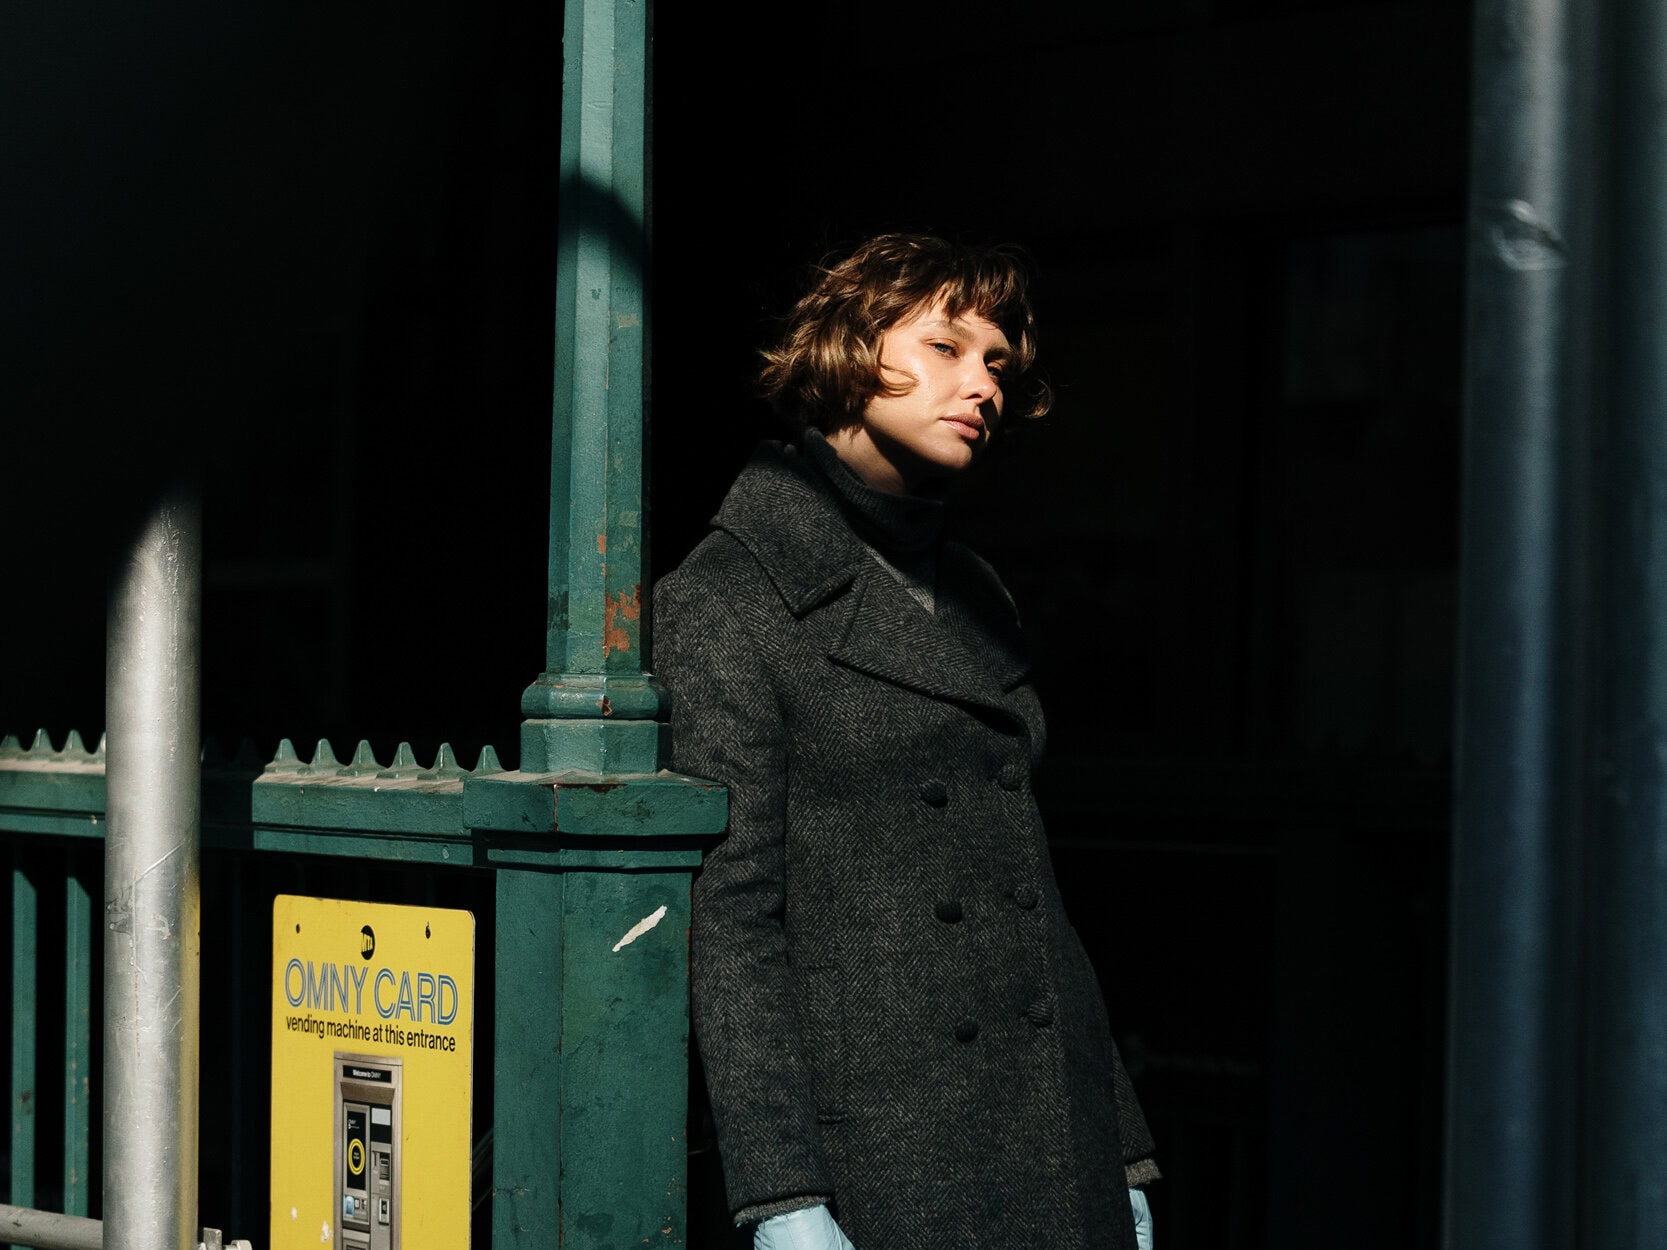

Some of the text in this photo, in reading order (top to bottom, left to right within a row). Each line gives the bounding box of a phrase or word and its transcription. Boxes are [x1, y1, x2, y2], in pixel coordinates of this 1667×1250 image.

[361, 933, 374, 953] MTA
[285, 958, 458, 1026] OMNY CARD
[286, 1014, 456, 1053] vending machine at this entrance
